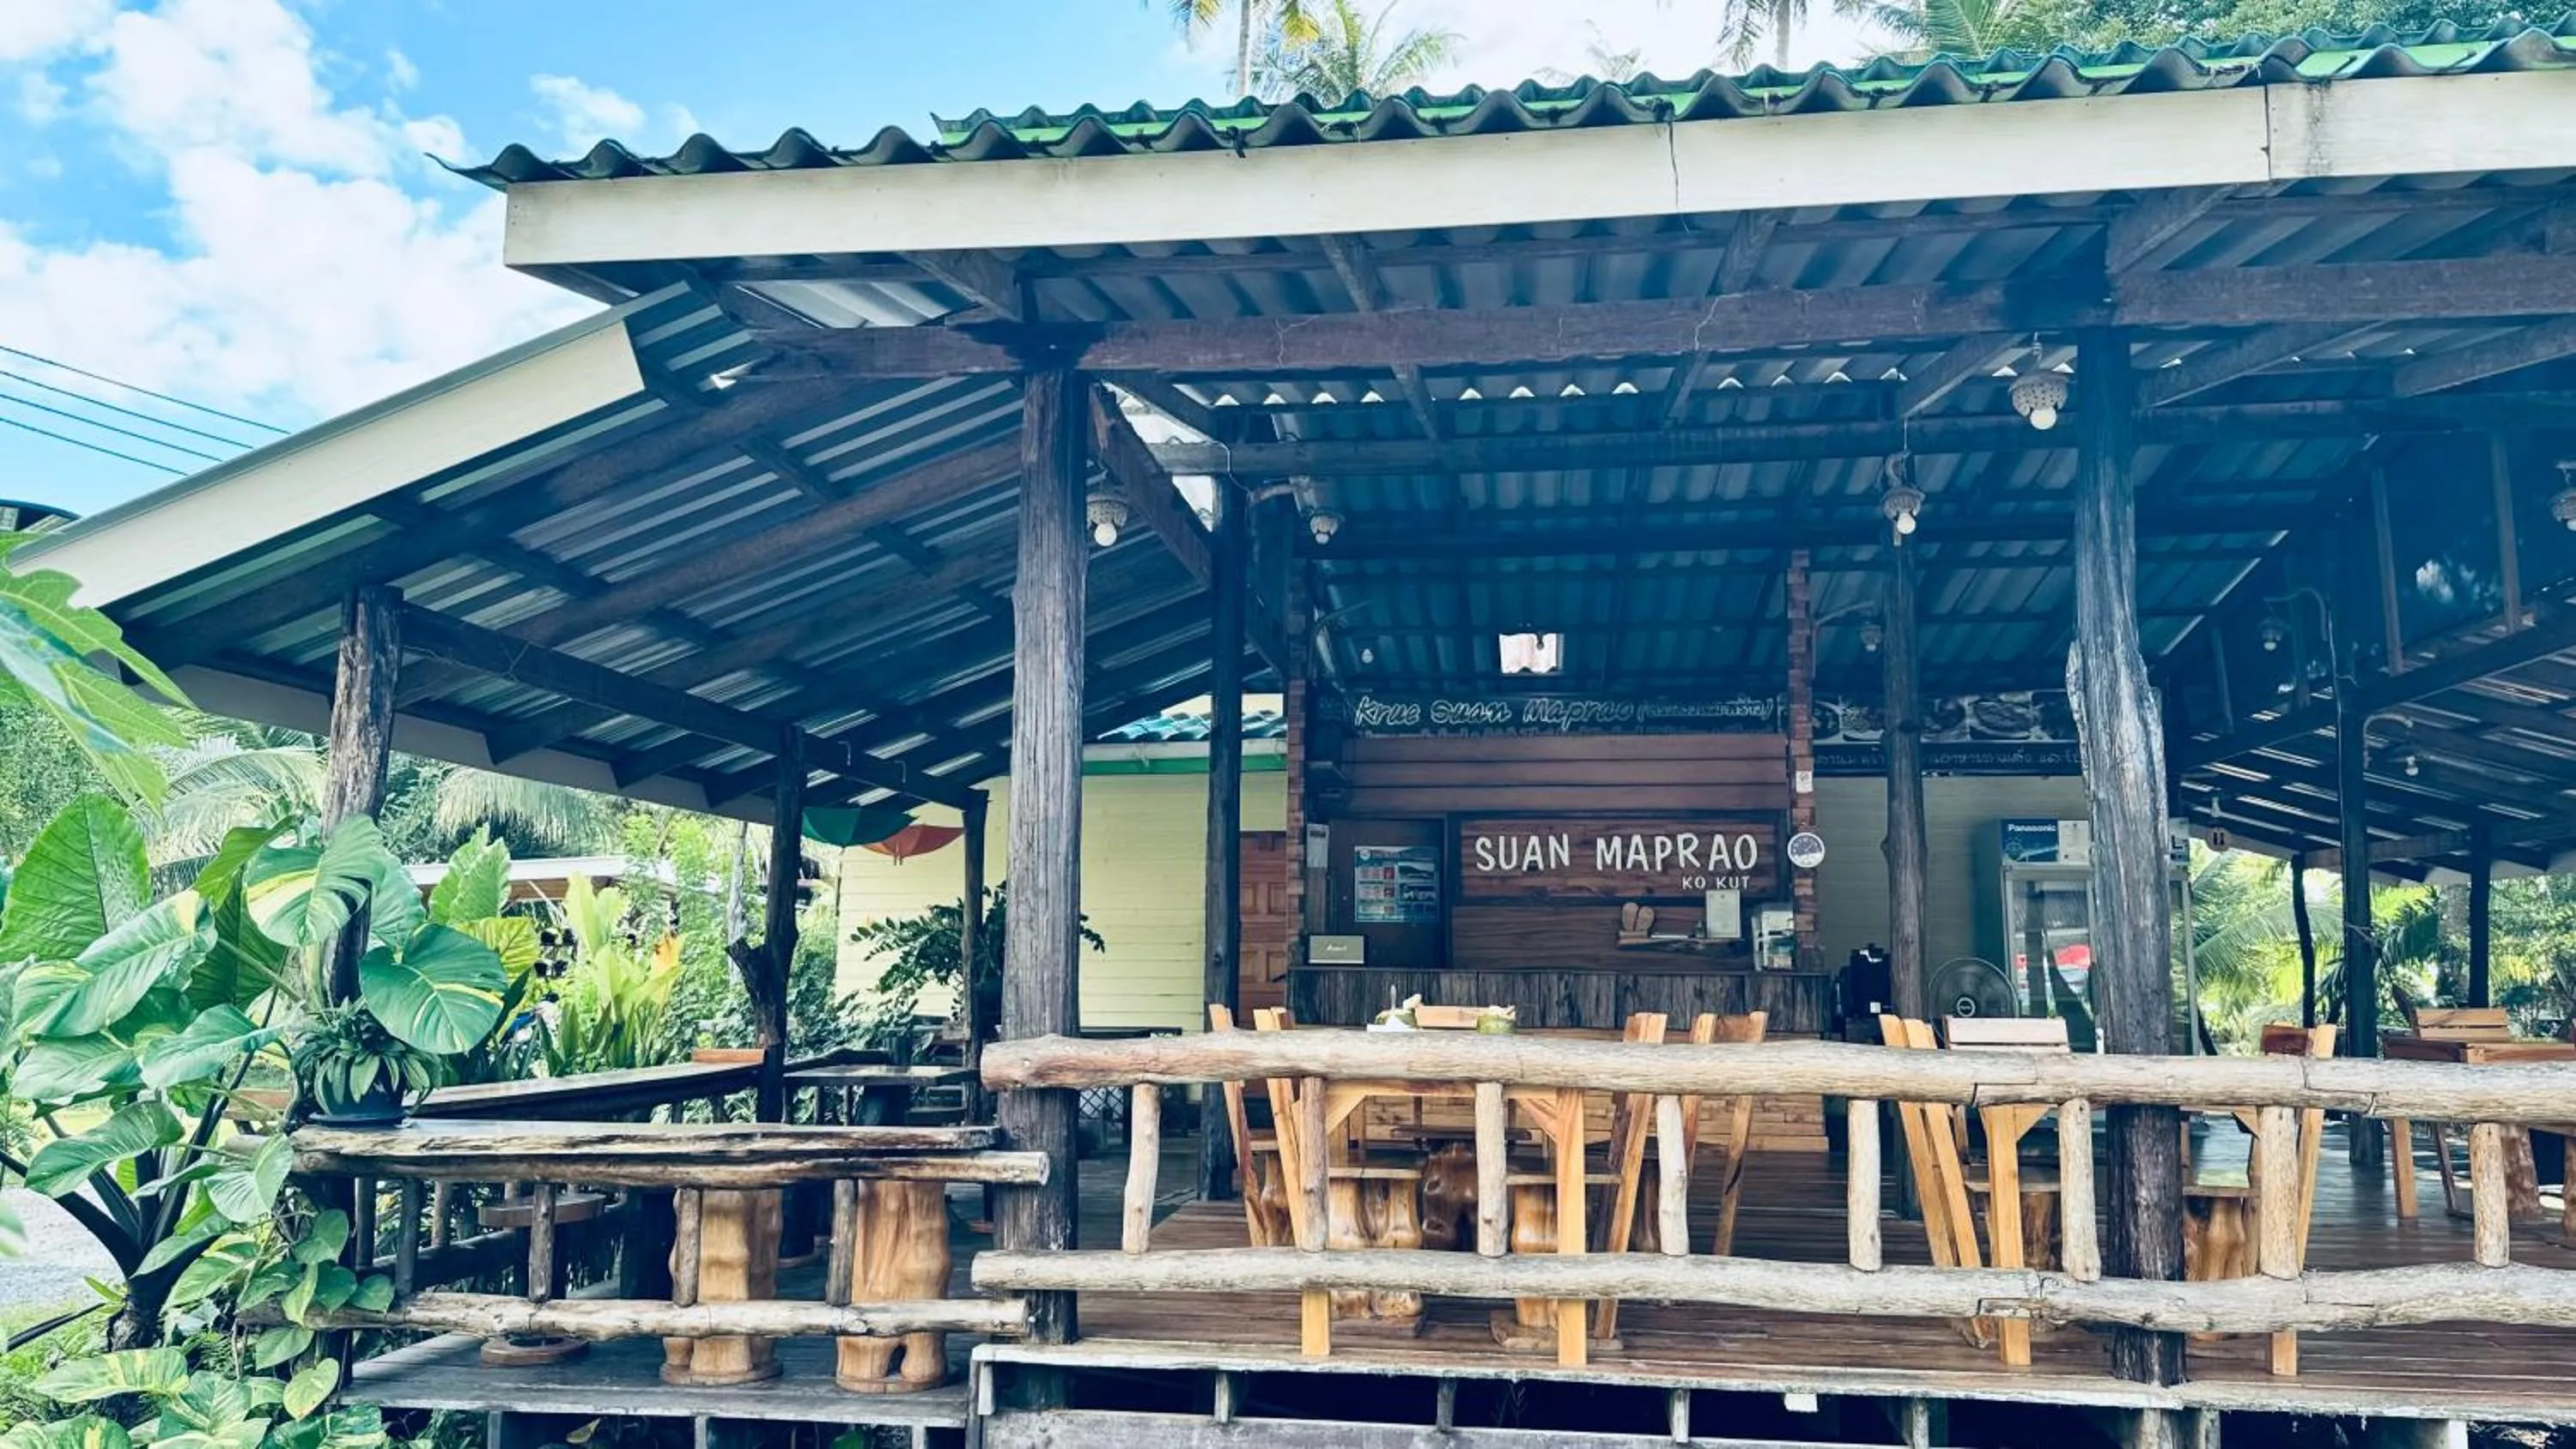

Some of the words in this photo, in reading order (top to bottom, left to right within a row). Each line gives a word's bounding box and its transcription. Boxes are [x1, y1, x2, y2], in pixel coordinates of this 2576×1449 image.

[1354, 695, 1421, 726] Krue
[1430, 700, 1512, 724] Suan
[1522, 698, 1634, 732] Maprao
[2008, 823, 2057, 832] Panasonic
[1475, 834, 1571, 872] SUAN
[1596, 833, 1758, 872] MAPRAO
[1682, 876, 1706, 889] KO
[1716, 876, 1751, 889] KUT
